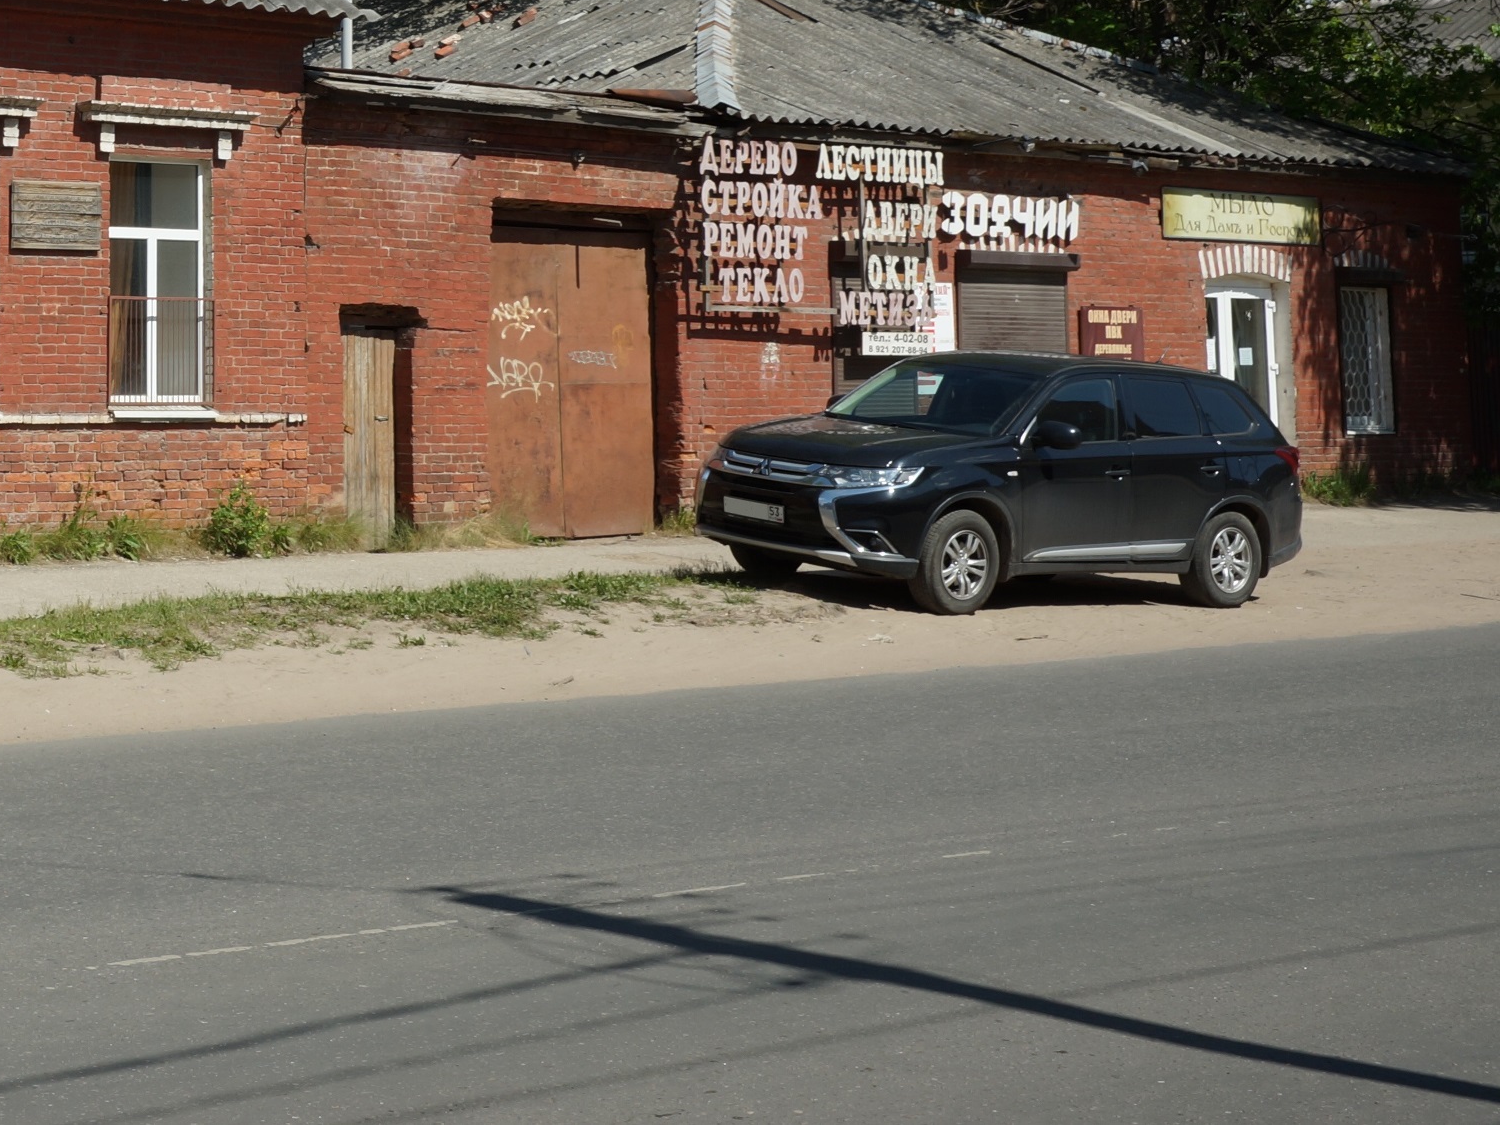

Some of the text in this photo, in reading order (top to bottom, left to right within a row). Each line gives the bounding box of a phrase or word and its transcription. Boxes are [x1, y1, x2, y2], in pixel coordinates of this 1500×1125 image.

[699, 135, 797, 176] ДЕРЕВО
[816, 143, 944, 188] ЛЕСТНИЦЫ
[701, 178, 823, 219] СТРОЙКА
[1210, 193, 1275, 216] МЫЛО
[862, 200, 938, 239] ДВЕРИ
[1173, 213, 1201, 232] Для
[1206, 215, 1242, 235] Дамъ
[1247, 223, 1254, 234] и
[703, 222, 808, 260] РЕМОНТ
[719, 268, 804, 303] ТЕКЛО
[867, 254, 936, 290] ОКНА
[1088, 309, 1137, 325] ОКНА ДВЕРИ
[868, 345, 874, 353] 8
[894, 334, 928, 343] 4-02-08
[769, 506, 780, 517] 53
